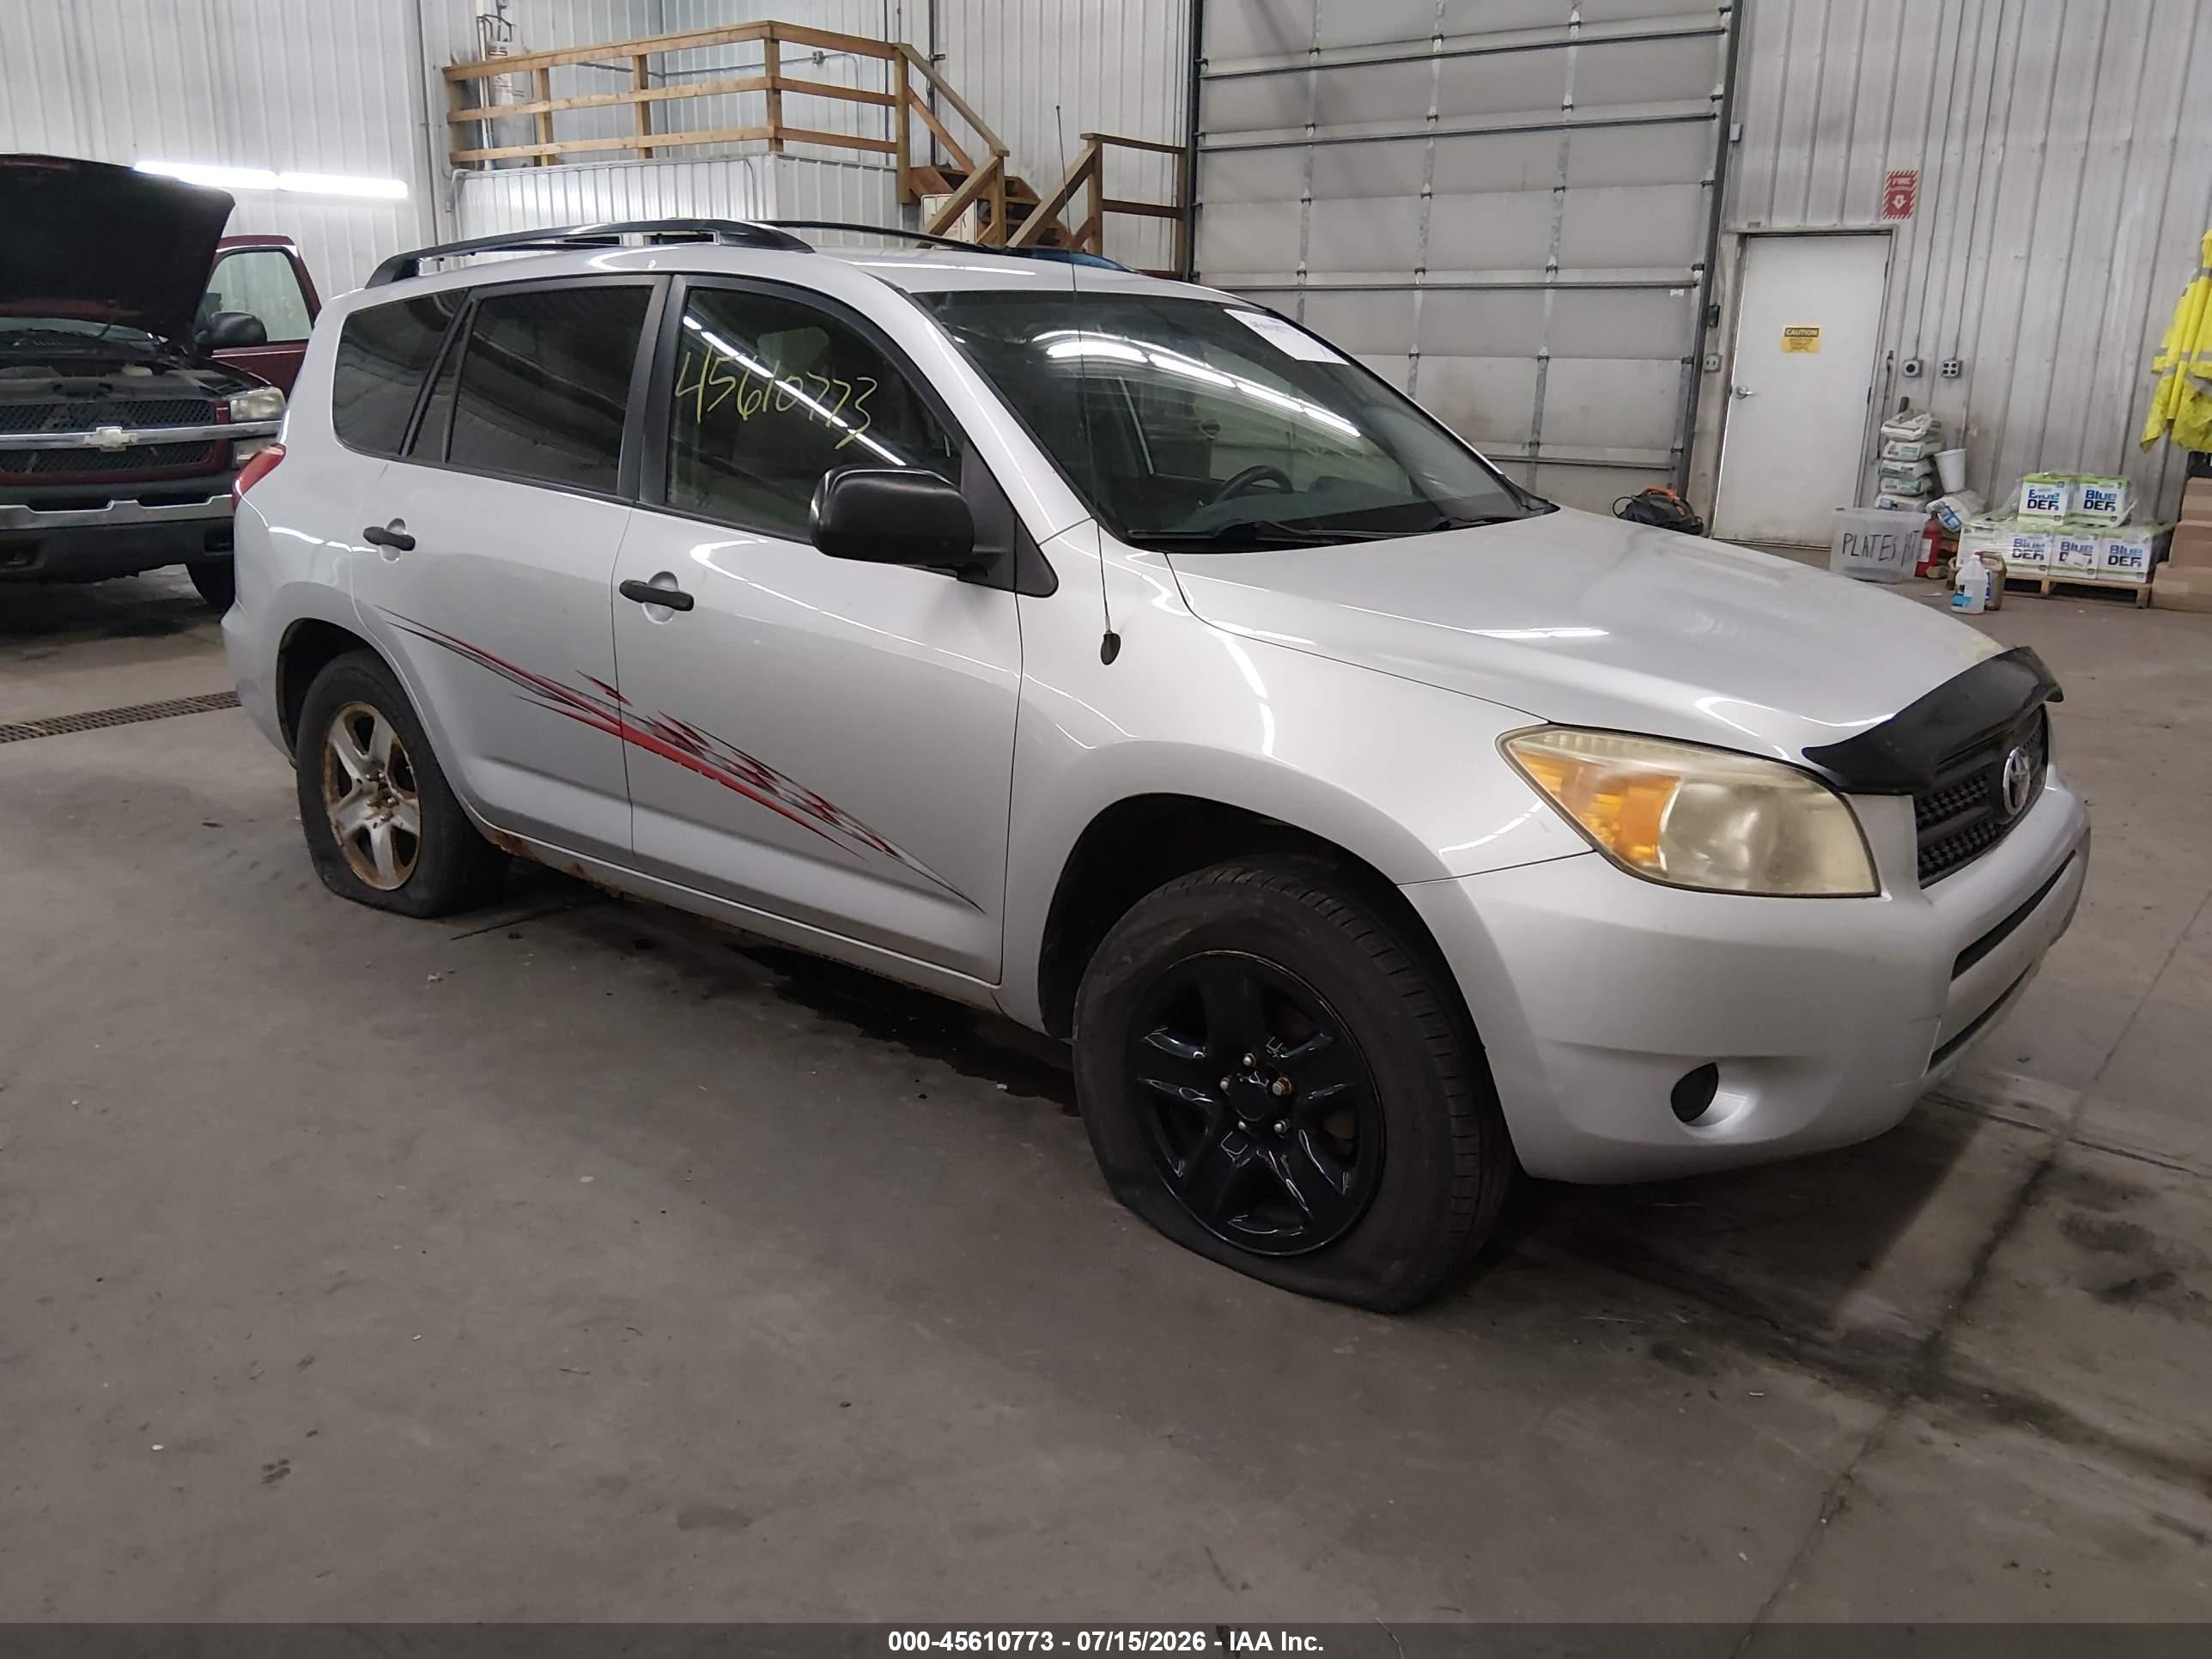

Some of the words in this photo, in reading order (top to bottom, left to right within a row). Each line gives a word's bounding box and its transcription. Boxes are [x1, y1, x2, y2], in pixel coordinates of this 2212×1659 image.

[675, 344, 878, 449] 45610773
[2086, 489, 2117, 501] Blue
[1842, 532, 1898, 562] PLATES
[2061, 541, 2094, 554] Blue
[2110, 544, 2143, 556] Blue
